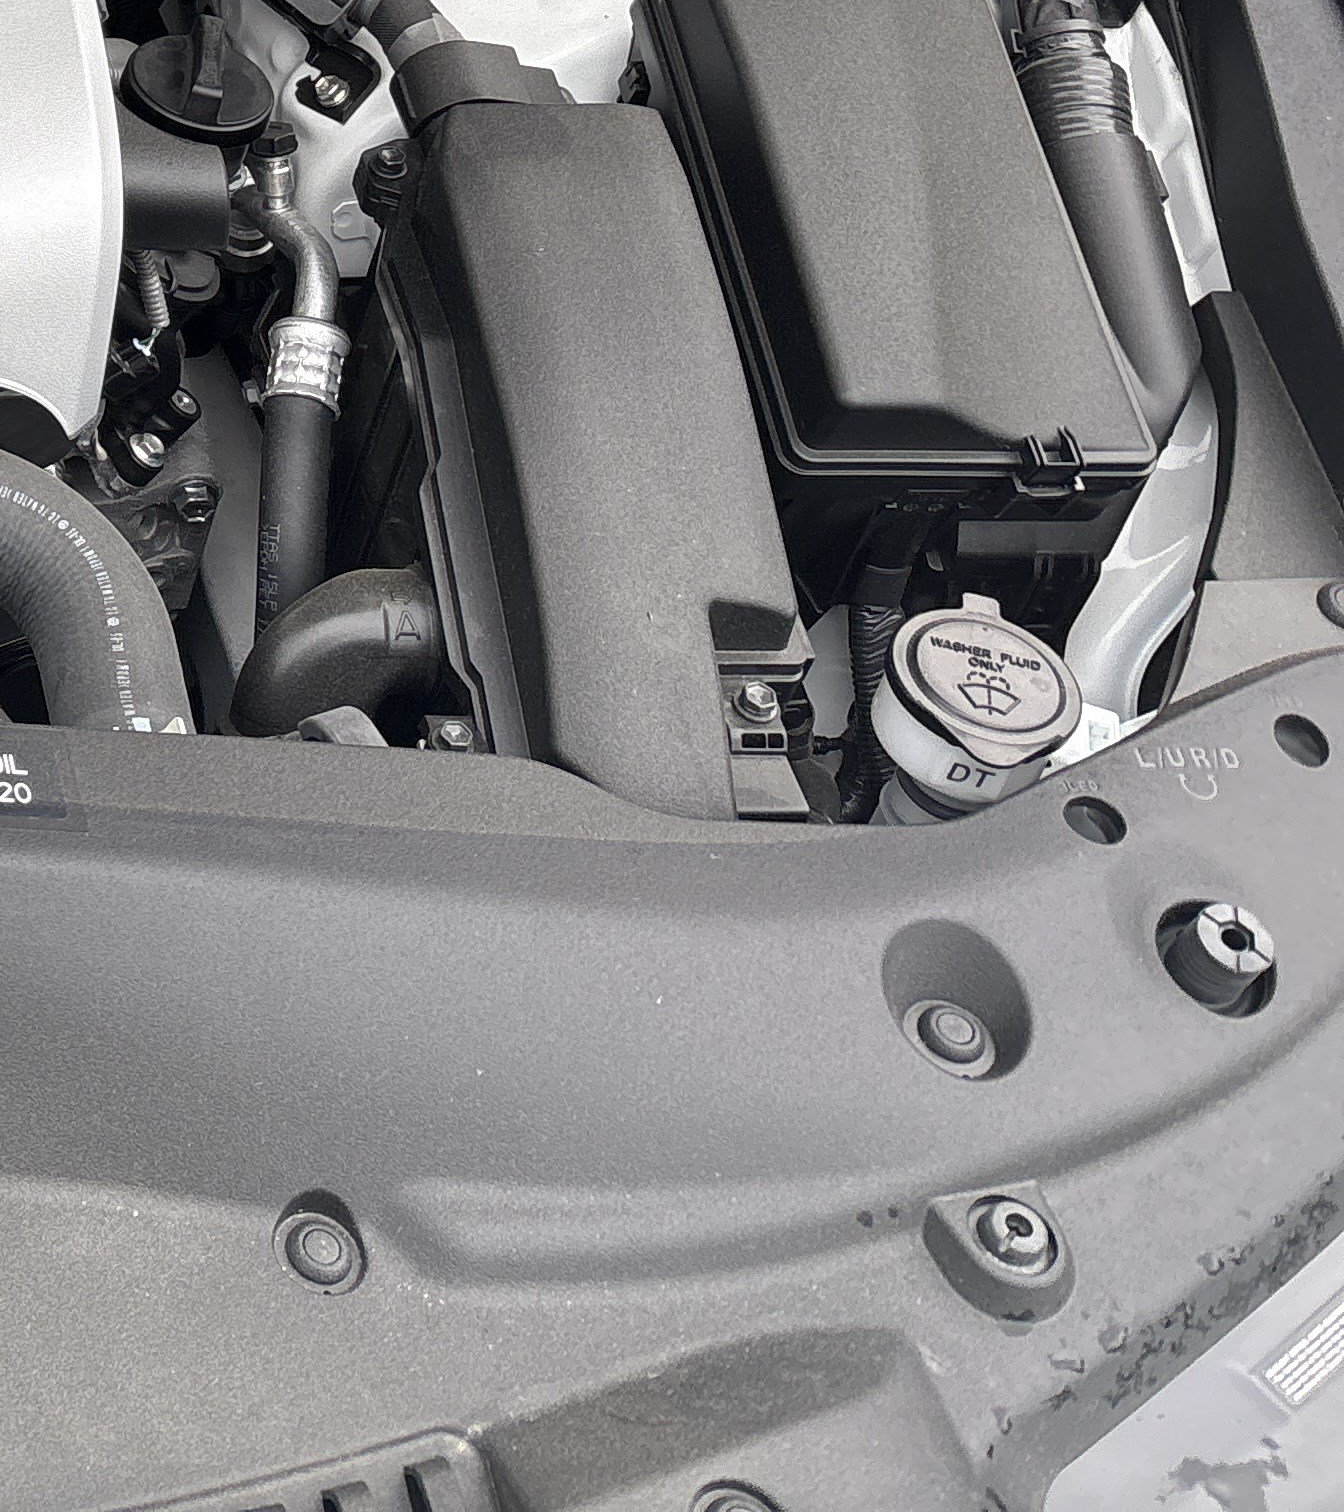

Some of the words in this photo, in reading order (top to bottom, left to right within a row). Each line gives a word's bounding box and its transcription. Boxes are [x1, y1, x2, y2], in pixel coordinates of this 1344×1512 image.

[929, 635, 993, 660] WASHER
[1000, 652, 1042, 672] FLUID
[967, 657, 1006, 674] ONLY
[946, 762, 998, 788] DT
